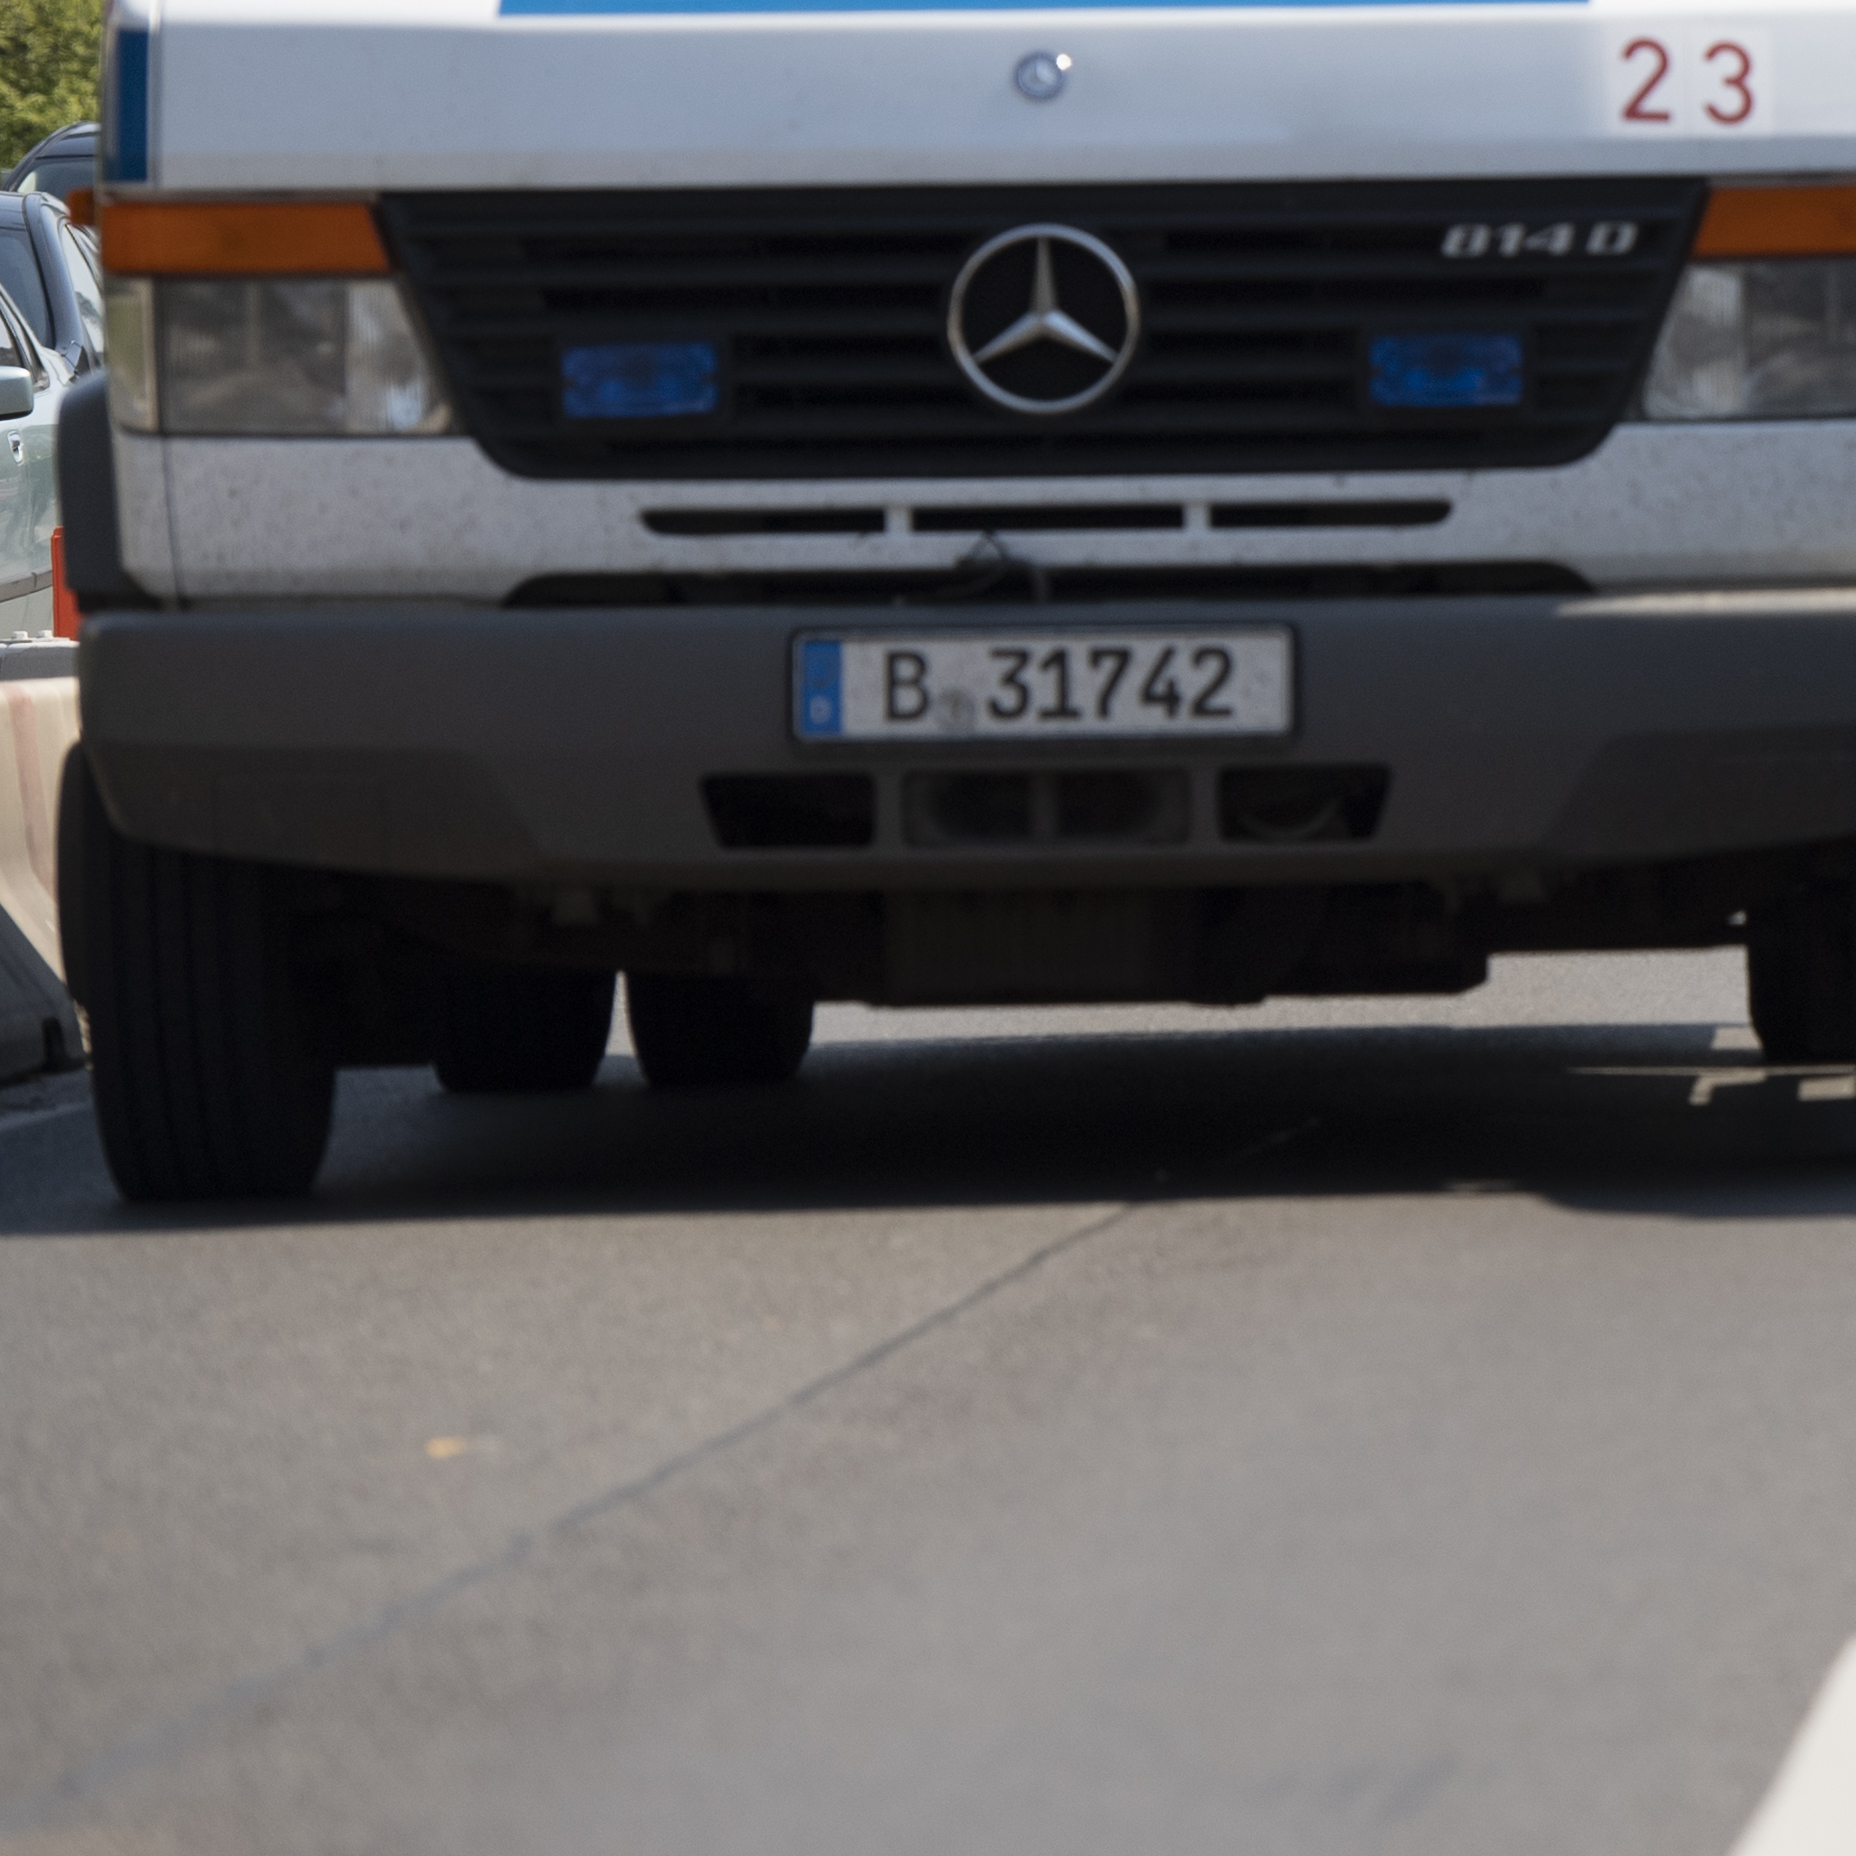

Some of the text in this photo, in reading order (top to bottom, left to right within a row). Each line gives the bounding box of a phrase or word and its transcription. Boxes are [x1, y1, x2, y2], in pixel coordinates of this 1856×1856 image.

[1619, 36, 1757, 124] 23
[884, 646, 1234, 723] B 31742
